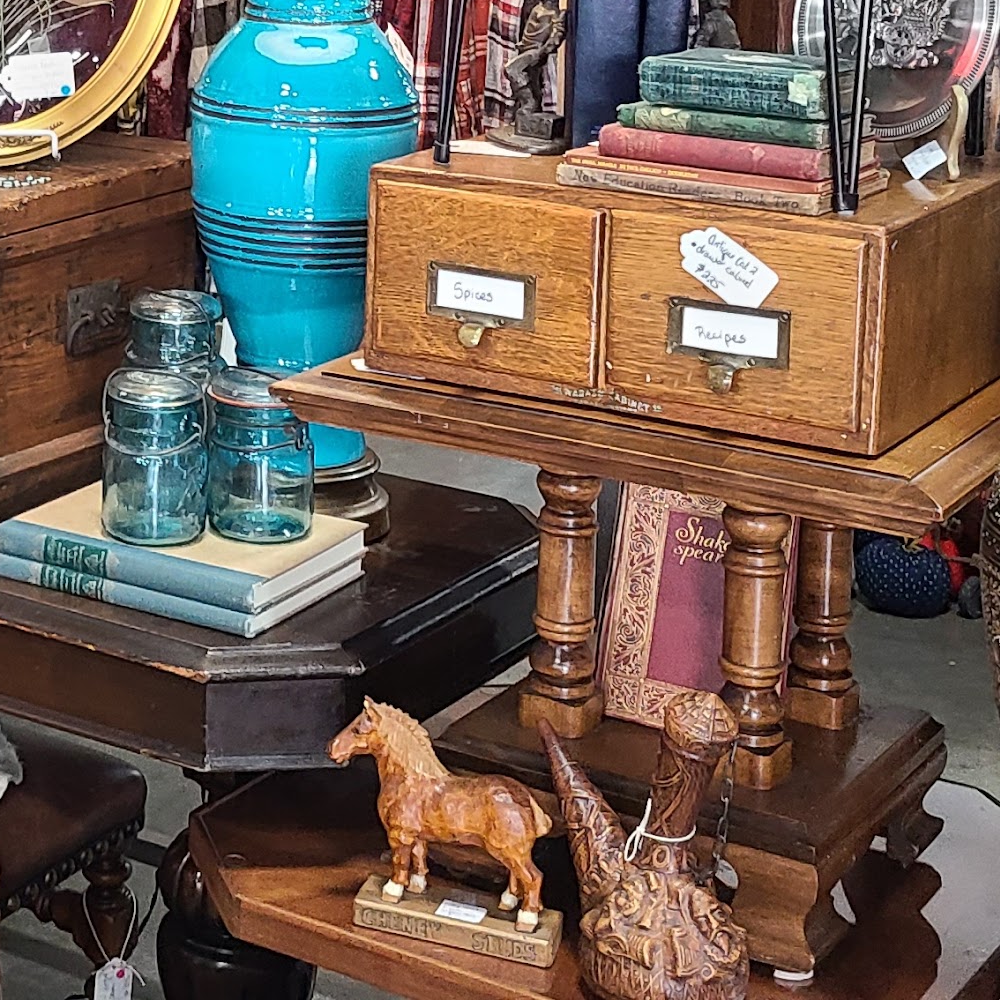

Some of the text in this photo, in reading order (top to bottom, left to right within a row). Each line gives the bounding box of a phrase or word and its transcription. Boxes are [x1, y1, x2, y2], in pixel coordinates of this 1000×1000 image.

[604, 172, 666, 191] Education
[733, 190, 768, 207] Book
[773, 195, 799, 209] Two
[453, 281, 494, 303] Spices
[694, 325, 747, 348] Recipes
[609, 387, 650, 413] CABINET
[673, 544, 725, 566] spear
[360, 906, 441, 938] CHENEY
[470, 931, 537, 961] STUDS
